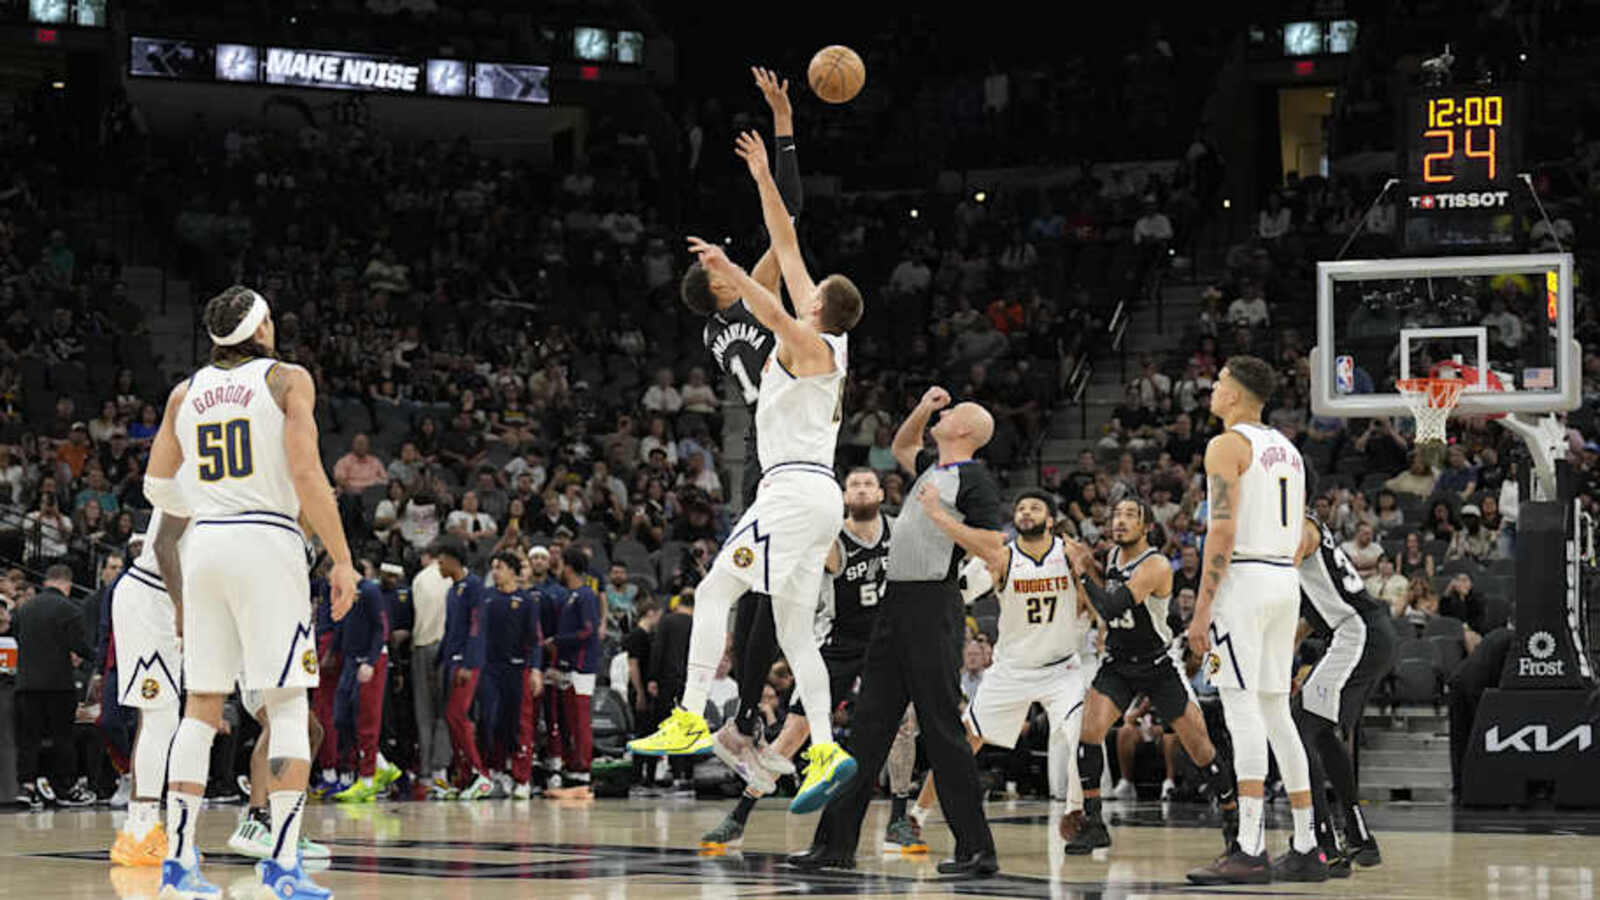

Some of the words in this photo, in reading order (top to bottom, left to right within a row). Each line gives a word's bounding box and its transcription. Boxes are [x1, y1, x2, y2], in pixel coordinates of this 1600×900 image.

[268, 50, 341, 81] MAKE
[341, 59, 419, 91] NOISE
[1428, 96, 1502, 127] 12:00
[1423, 128, 1496, 182] 24
[1435, 191, 1508, 208] TISSOT
[729, 354, 760, 405] 1
[192, 385, 254, 415] GORDON
[196, 417, 254, 482] 50
[1279, 477, 1288, 528] 1
[1013, 576, 1069, 593] NUGGETS
[1027, 597, 1057, 625] 27
[1518, 657, 1565, 676] Frost
